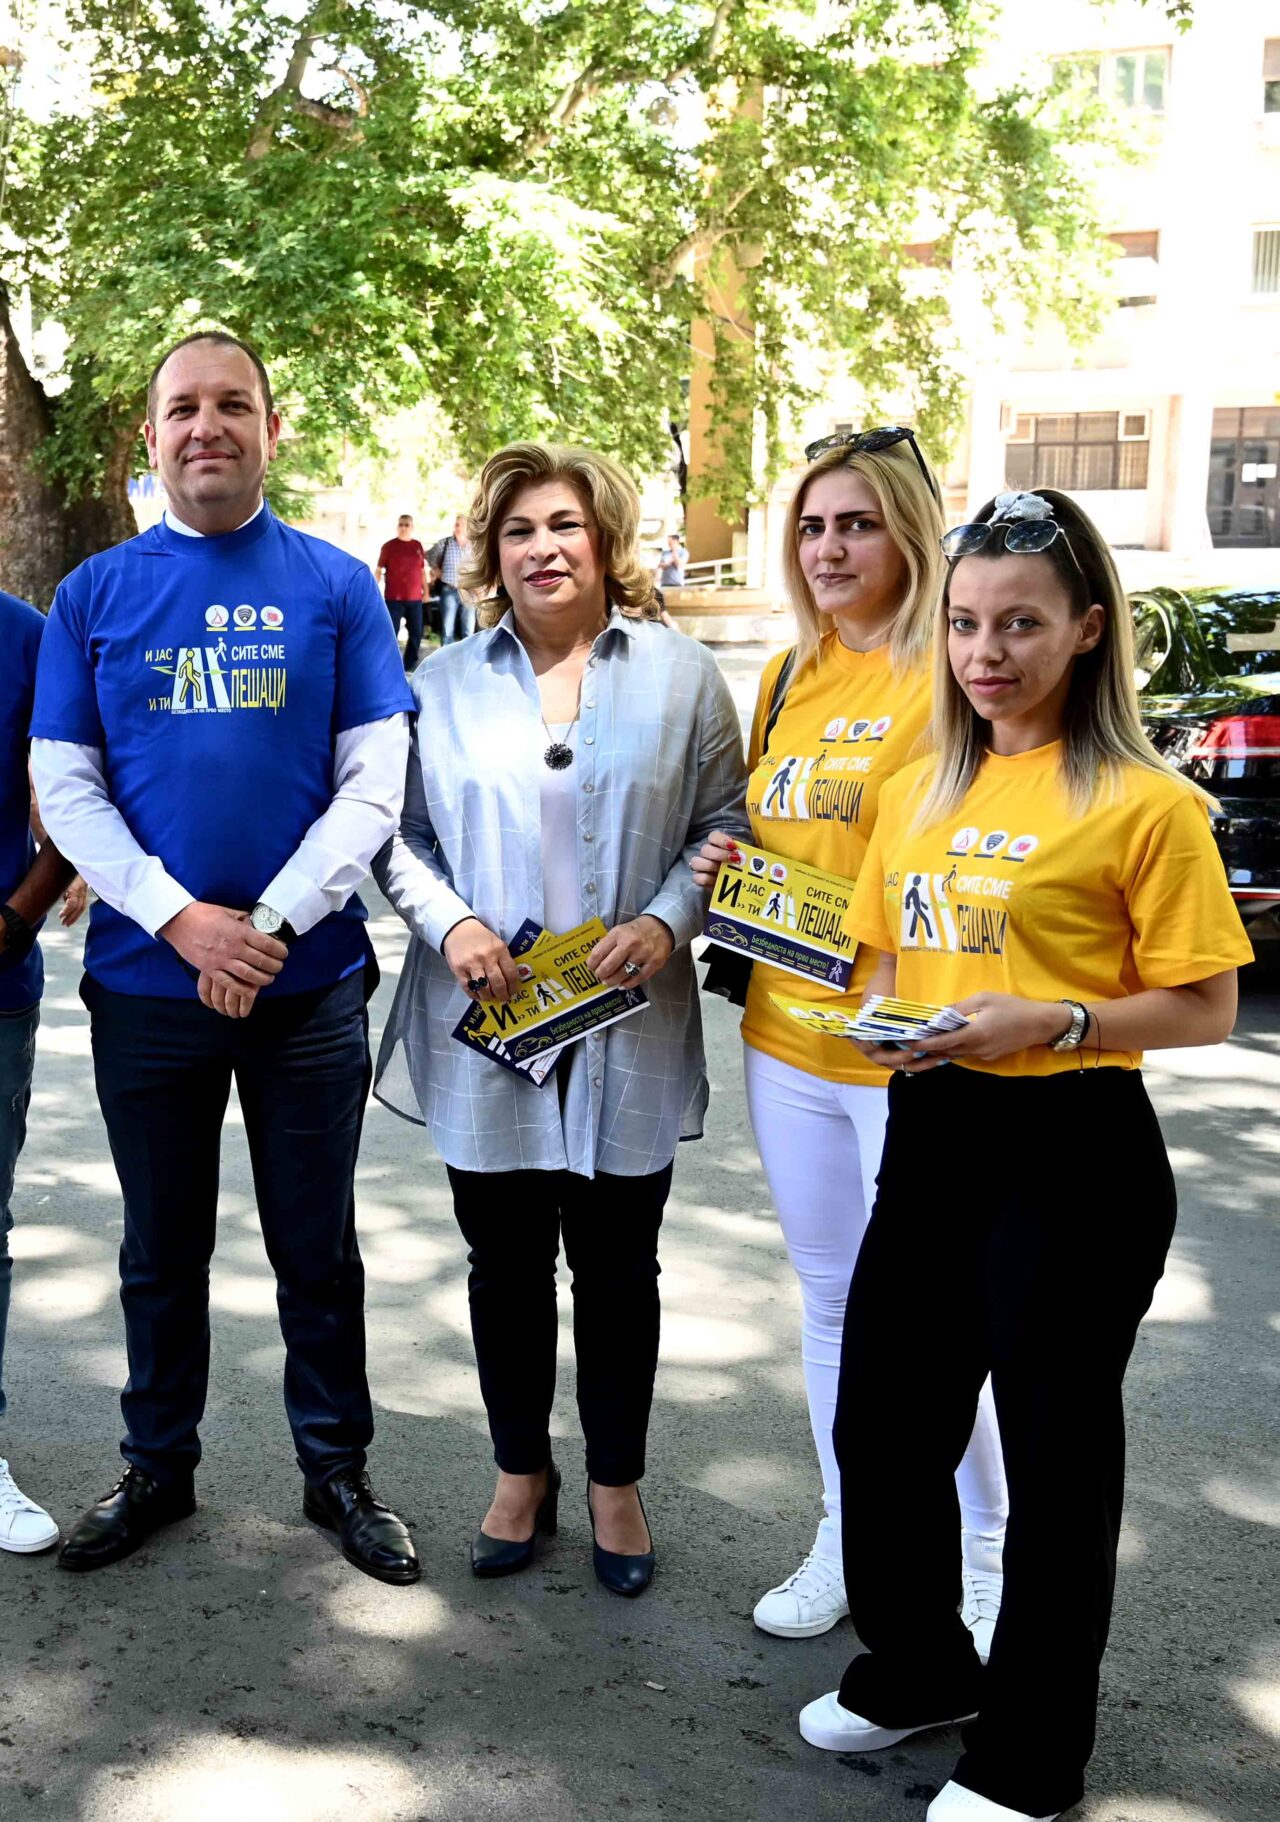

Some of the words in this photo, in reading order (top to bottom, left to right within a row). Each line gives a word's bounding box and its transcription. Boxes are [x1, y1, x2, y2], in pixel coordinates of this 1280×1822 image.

[145, 650, 153, 662] И
[231, 645, 259, 661] СИТЕ
[260, 644, 285, 660] СМЕ
[231, 667, 286, 716] ПЕШАЦИ
[149, 698, 157, 711] И
[158, 697, 171, 710] ТИ
[823, 757, 848, 772] СИТЕ
[847, 757, 873, 773] СМЕ
[809, 779, 864, 831] ПЕШАЦИ
[717, 874, 743, 908] И
[982, 876, 1014, 900] СМЕ
[806, 886, 833, 905] СИТЕ
[834, 897, 850, 910] СМ
[748, 903, 761, 917] ТИ
[553, 948, 581, 967] СИТЕ
[489, 1002, 519, 1031] И
[525, 1005, 540, 1018] ТИ
